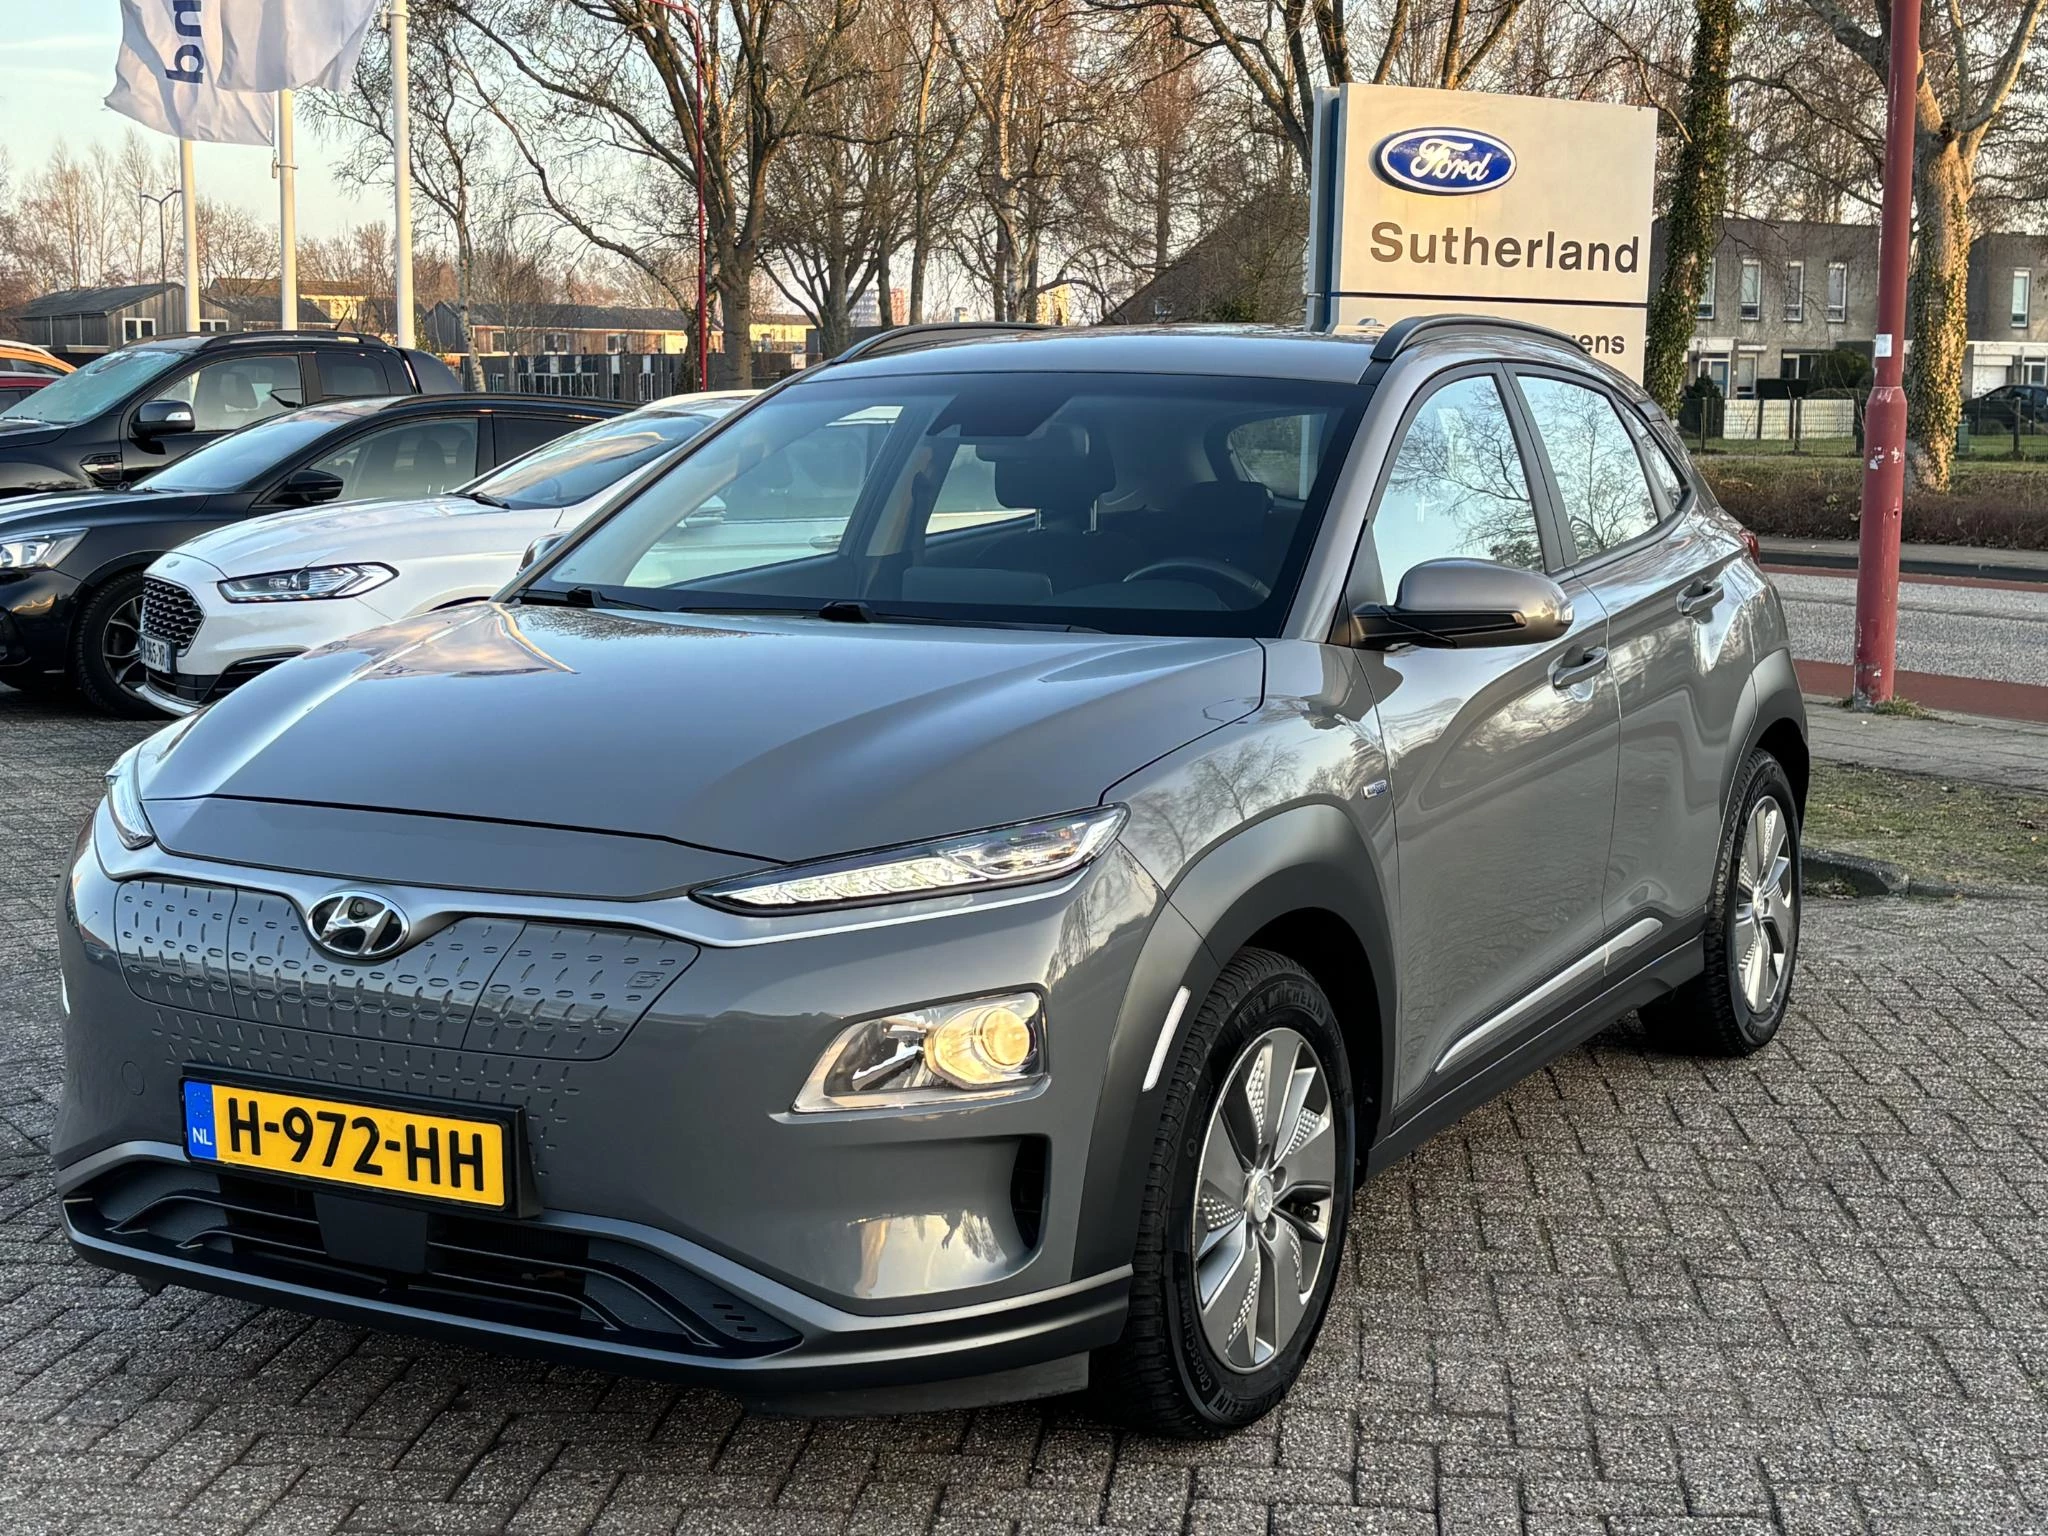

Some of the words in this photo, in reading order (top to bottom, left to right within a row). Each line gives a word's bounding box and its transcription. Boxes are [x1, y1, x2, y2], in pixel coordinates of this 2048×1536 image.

[1410, 138, 1493, 181] Ford
[1370, 221, 1639, 273] Sutherland
[1571, 334, 1625, 354] ens
[192, 1126, 213, 1146] NL
[228, 1097, 484, 1192] H-972-HH
